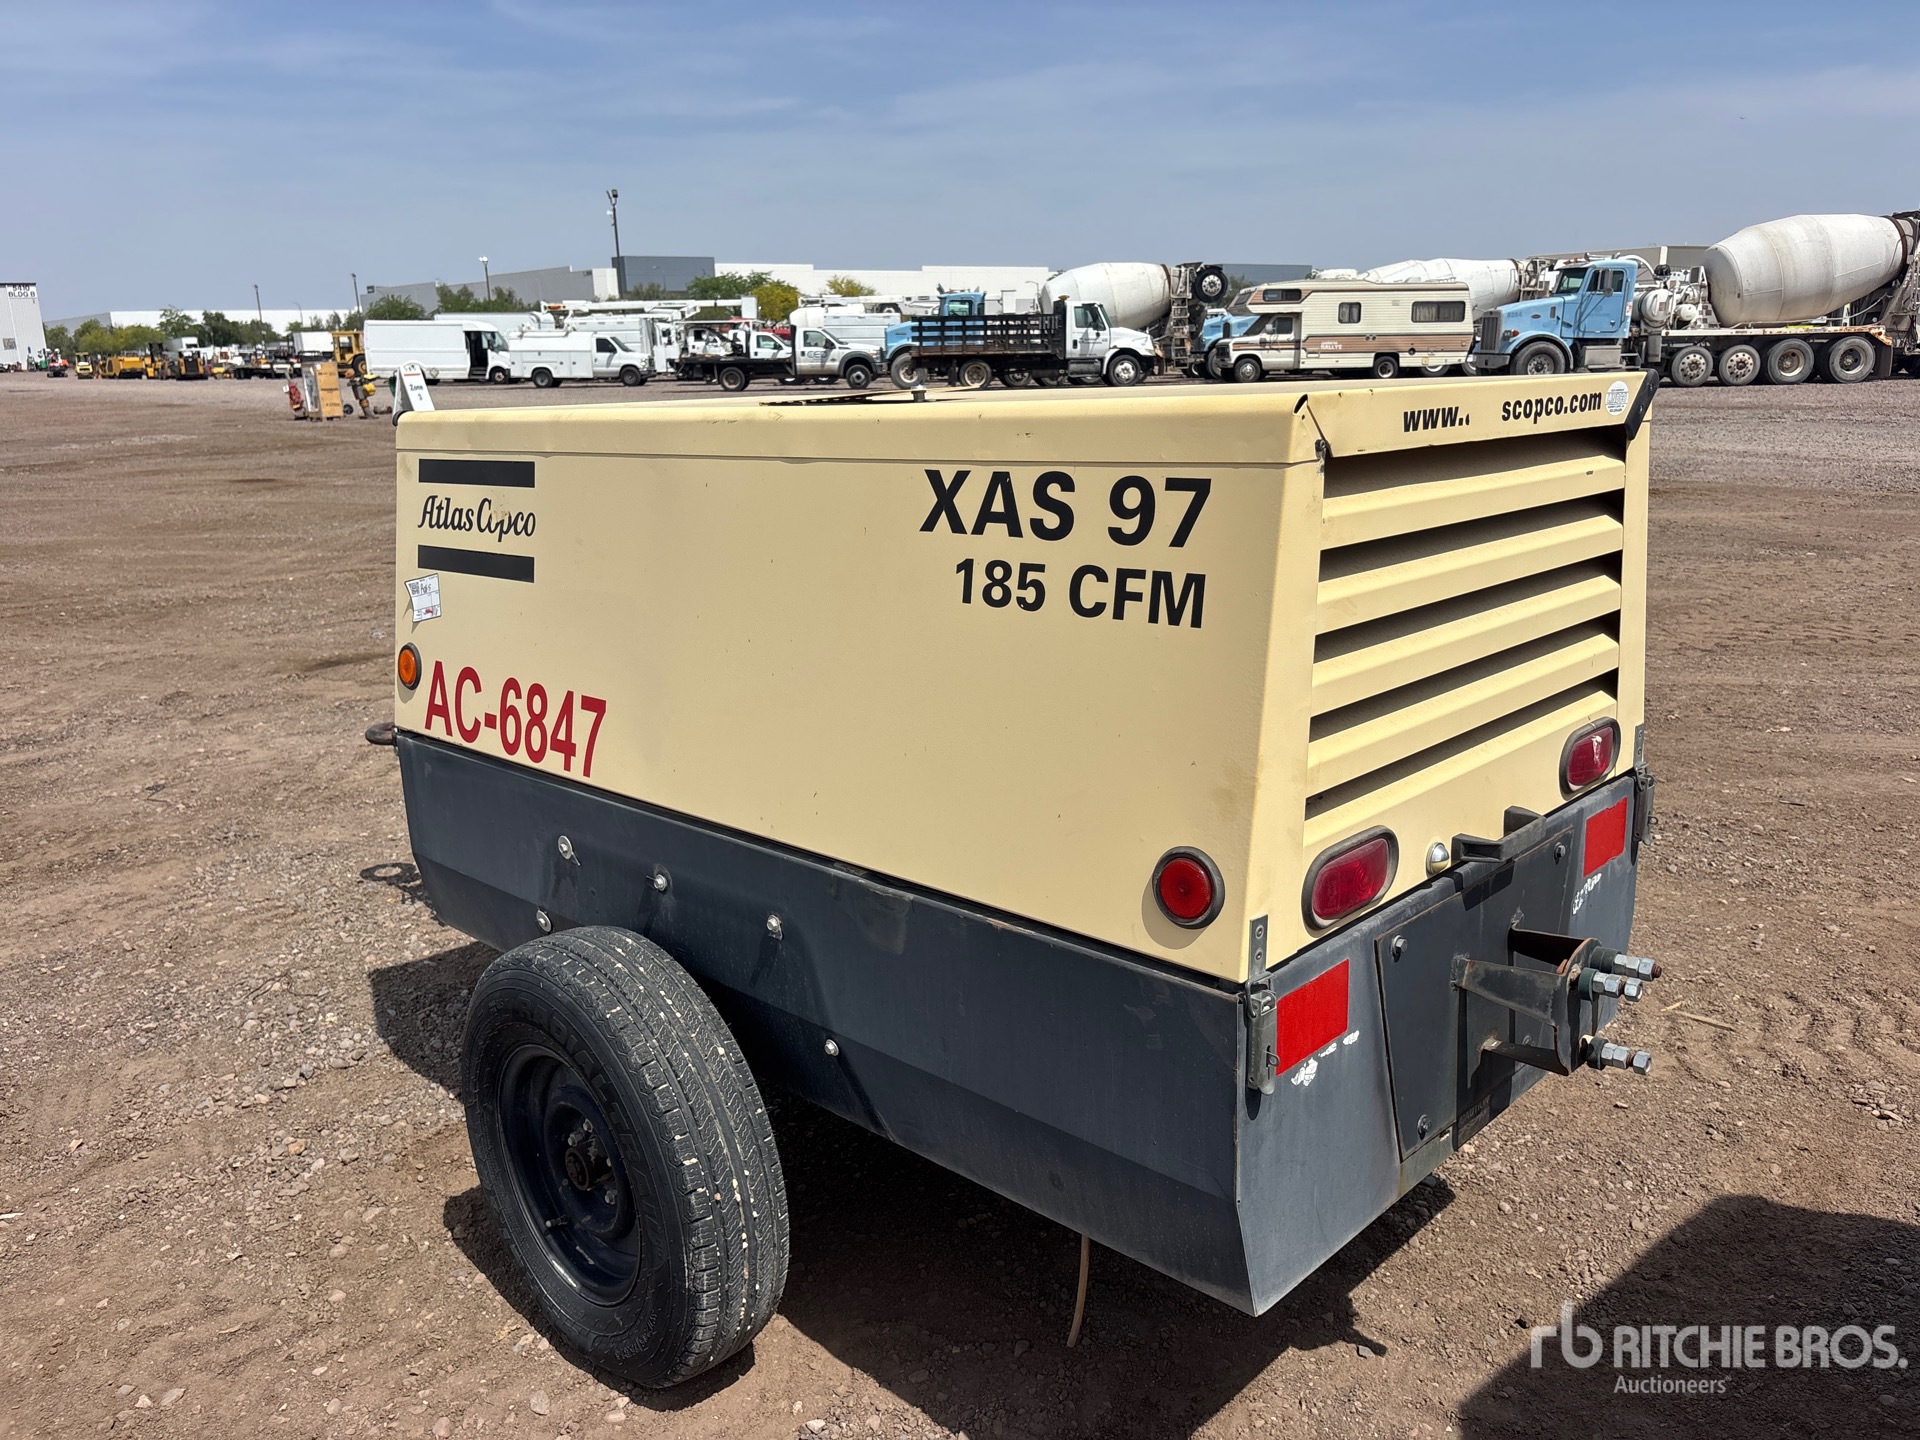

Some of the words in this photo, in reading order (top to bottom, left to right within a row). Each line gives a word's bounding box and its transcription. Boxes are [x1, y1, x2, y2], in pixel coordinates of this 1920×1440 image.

[1501, 392, 1602, 424] scopco.com
[417, 495, 475, 532] Atlas
[919, 469, 1076, 542] XAS
[1107, 475, 1212, 548] 97
[956, 558, 1046, 612] 185
[1069, 564, 1206, 629] CFM
[424, 661, 607, 777] AC-6847
[513, 996, 608, 1101] RADIAL
